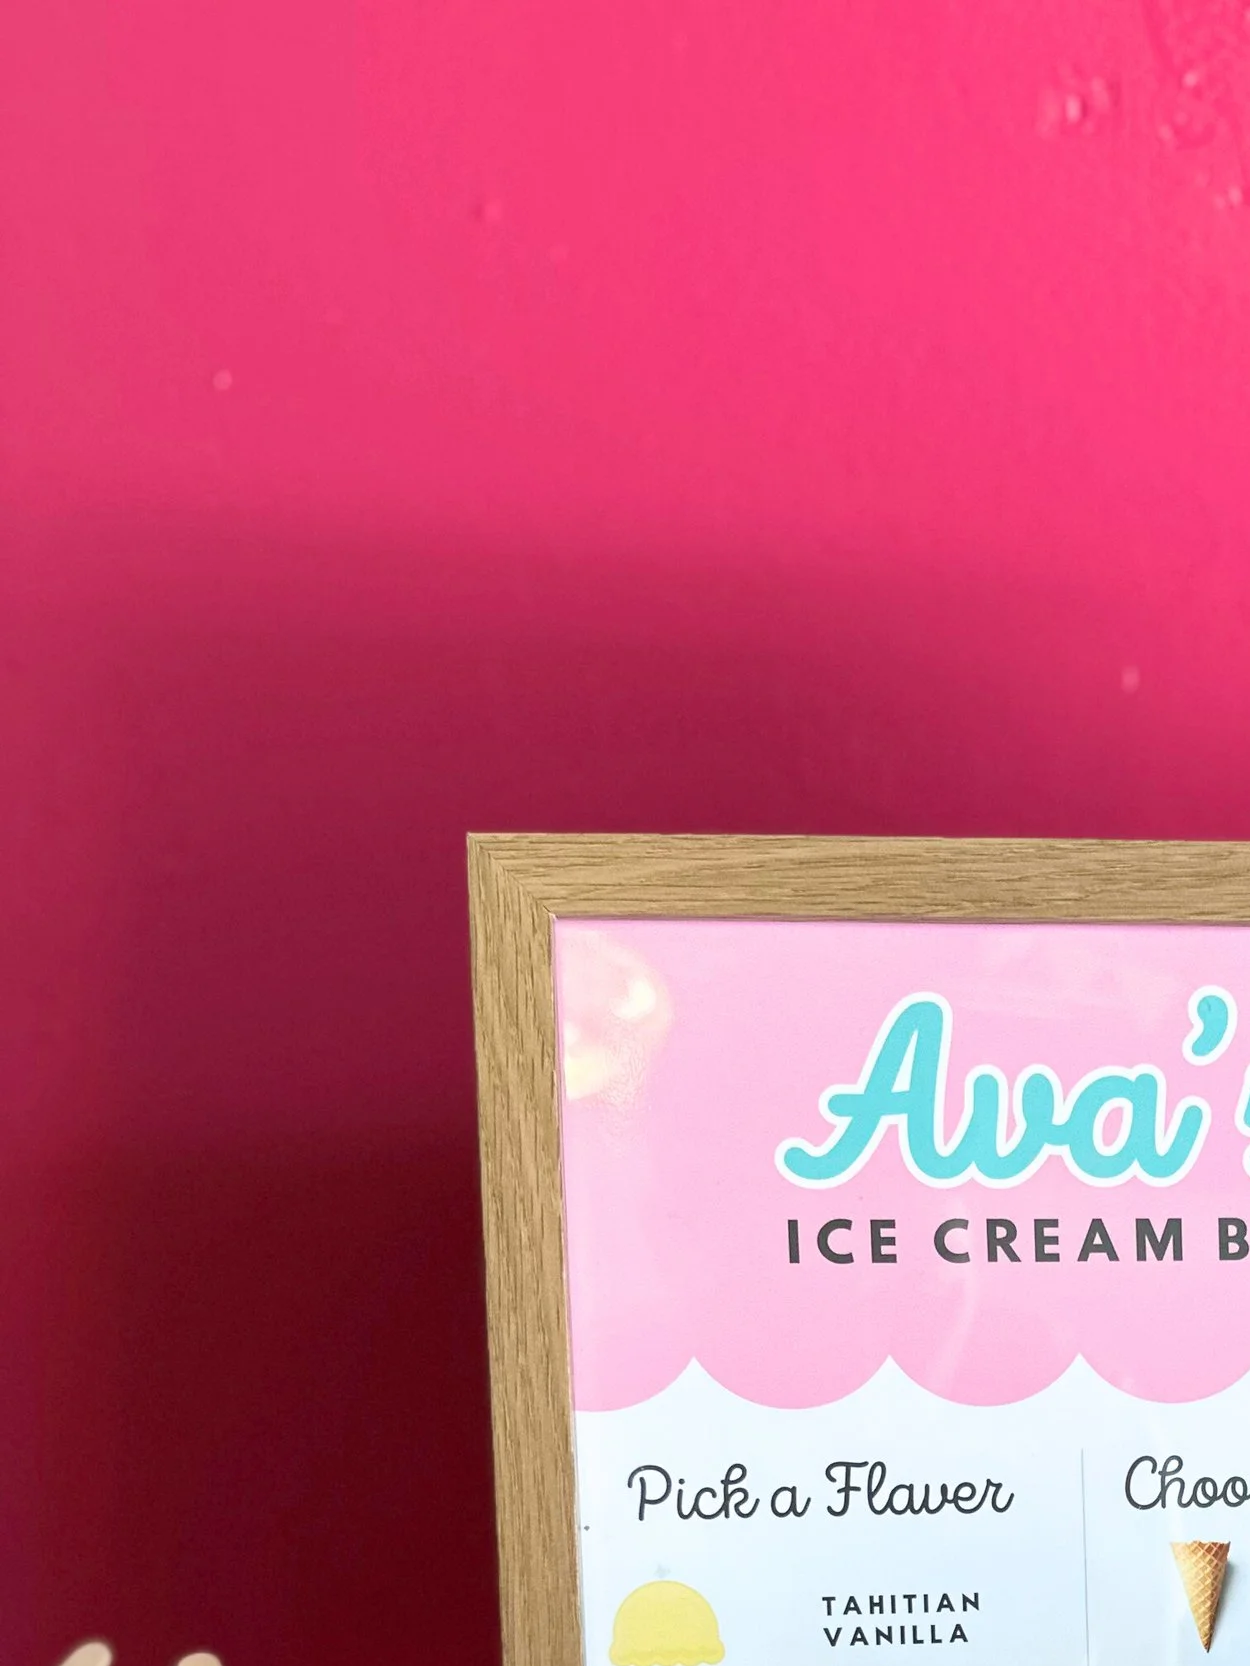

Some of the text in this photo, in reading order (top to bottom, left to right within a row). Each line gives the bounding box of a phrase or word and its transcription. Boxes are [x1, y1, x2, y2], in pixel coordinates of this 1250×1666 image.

[787, 1218, 898, 1264] ICE
[933, 1217, 1184, 1264] CREAM
[628, 1463, 761, 1521] Pick
[770, 1485, 811, 1518] a
[822, 1592, 980, 1616] TAHITIAN
[823, 1623, 969, 1647] VANILLA
